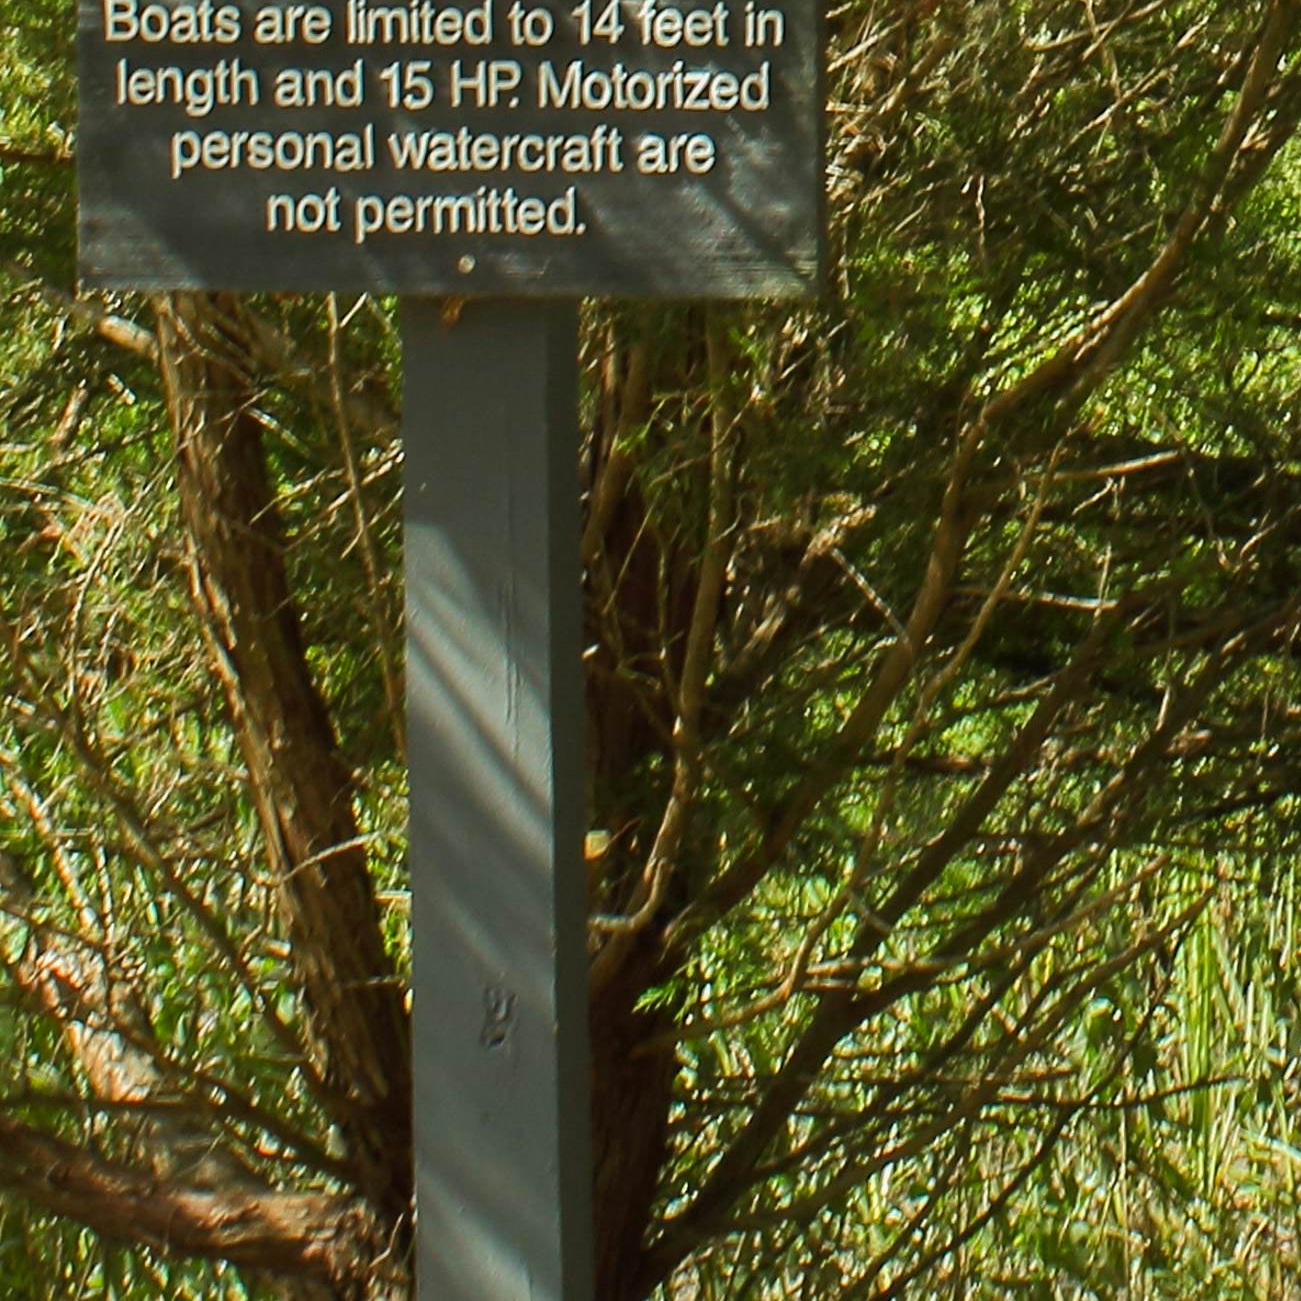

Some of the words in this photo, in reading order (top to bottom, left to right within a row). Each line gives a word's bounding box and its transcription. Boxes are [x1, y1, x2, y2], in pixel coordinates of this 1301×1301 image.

[254, 3, 331, 44] are
[507, 2, 554, 45] to
[572, 0, 624, 46] 14
[745, 1, 784, 47] in
[117, 60, 258, 116] length
[274, 62, 364, 107] and
[379, 62, 432, 107] 15
[450, 62, 520, 109] HP.
[538, 63, 770, 111] Motorized
[171, 125, 374, 178] personal
[388, 126, 623, 172] watercraft
[636, 132, 716, 173] are
[267, 190, 340, 232] not
[355, 189, 586, 243] permitted.
